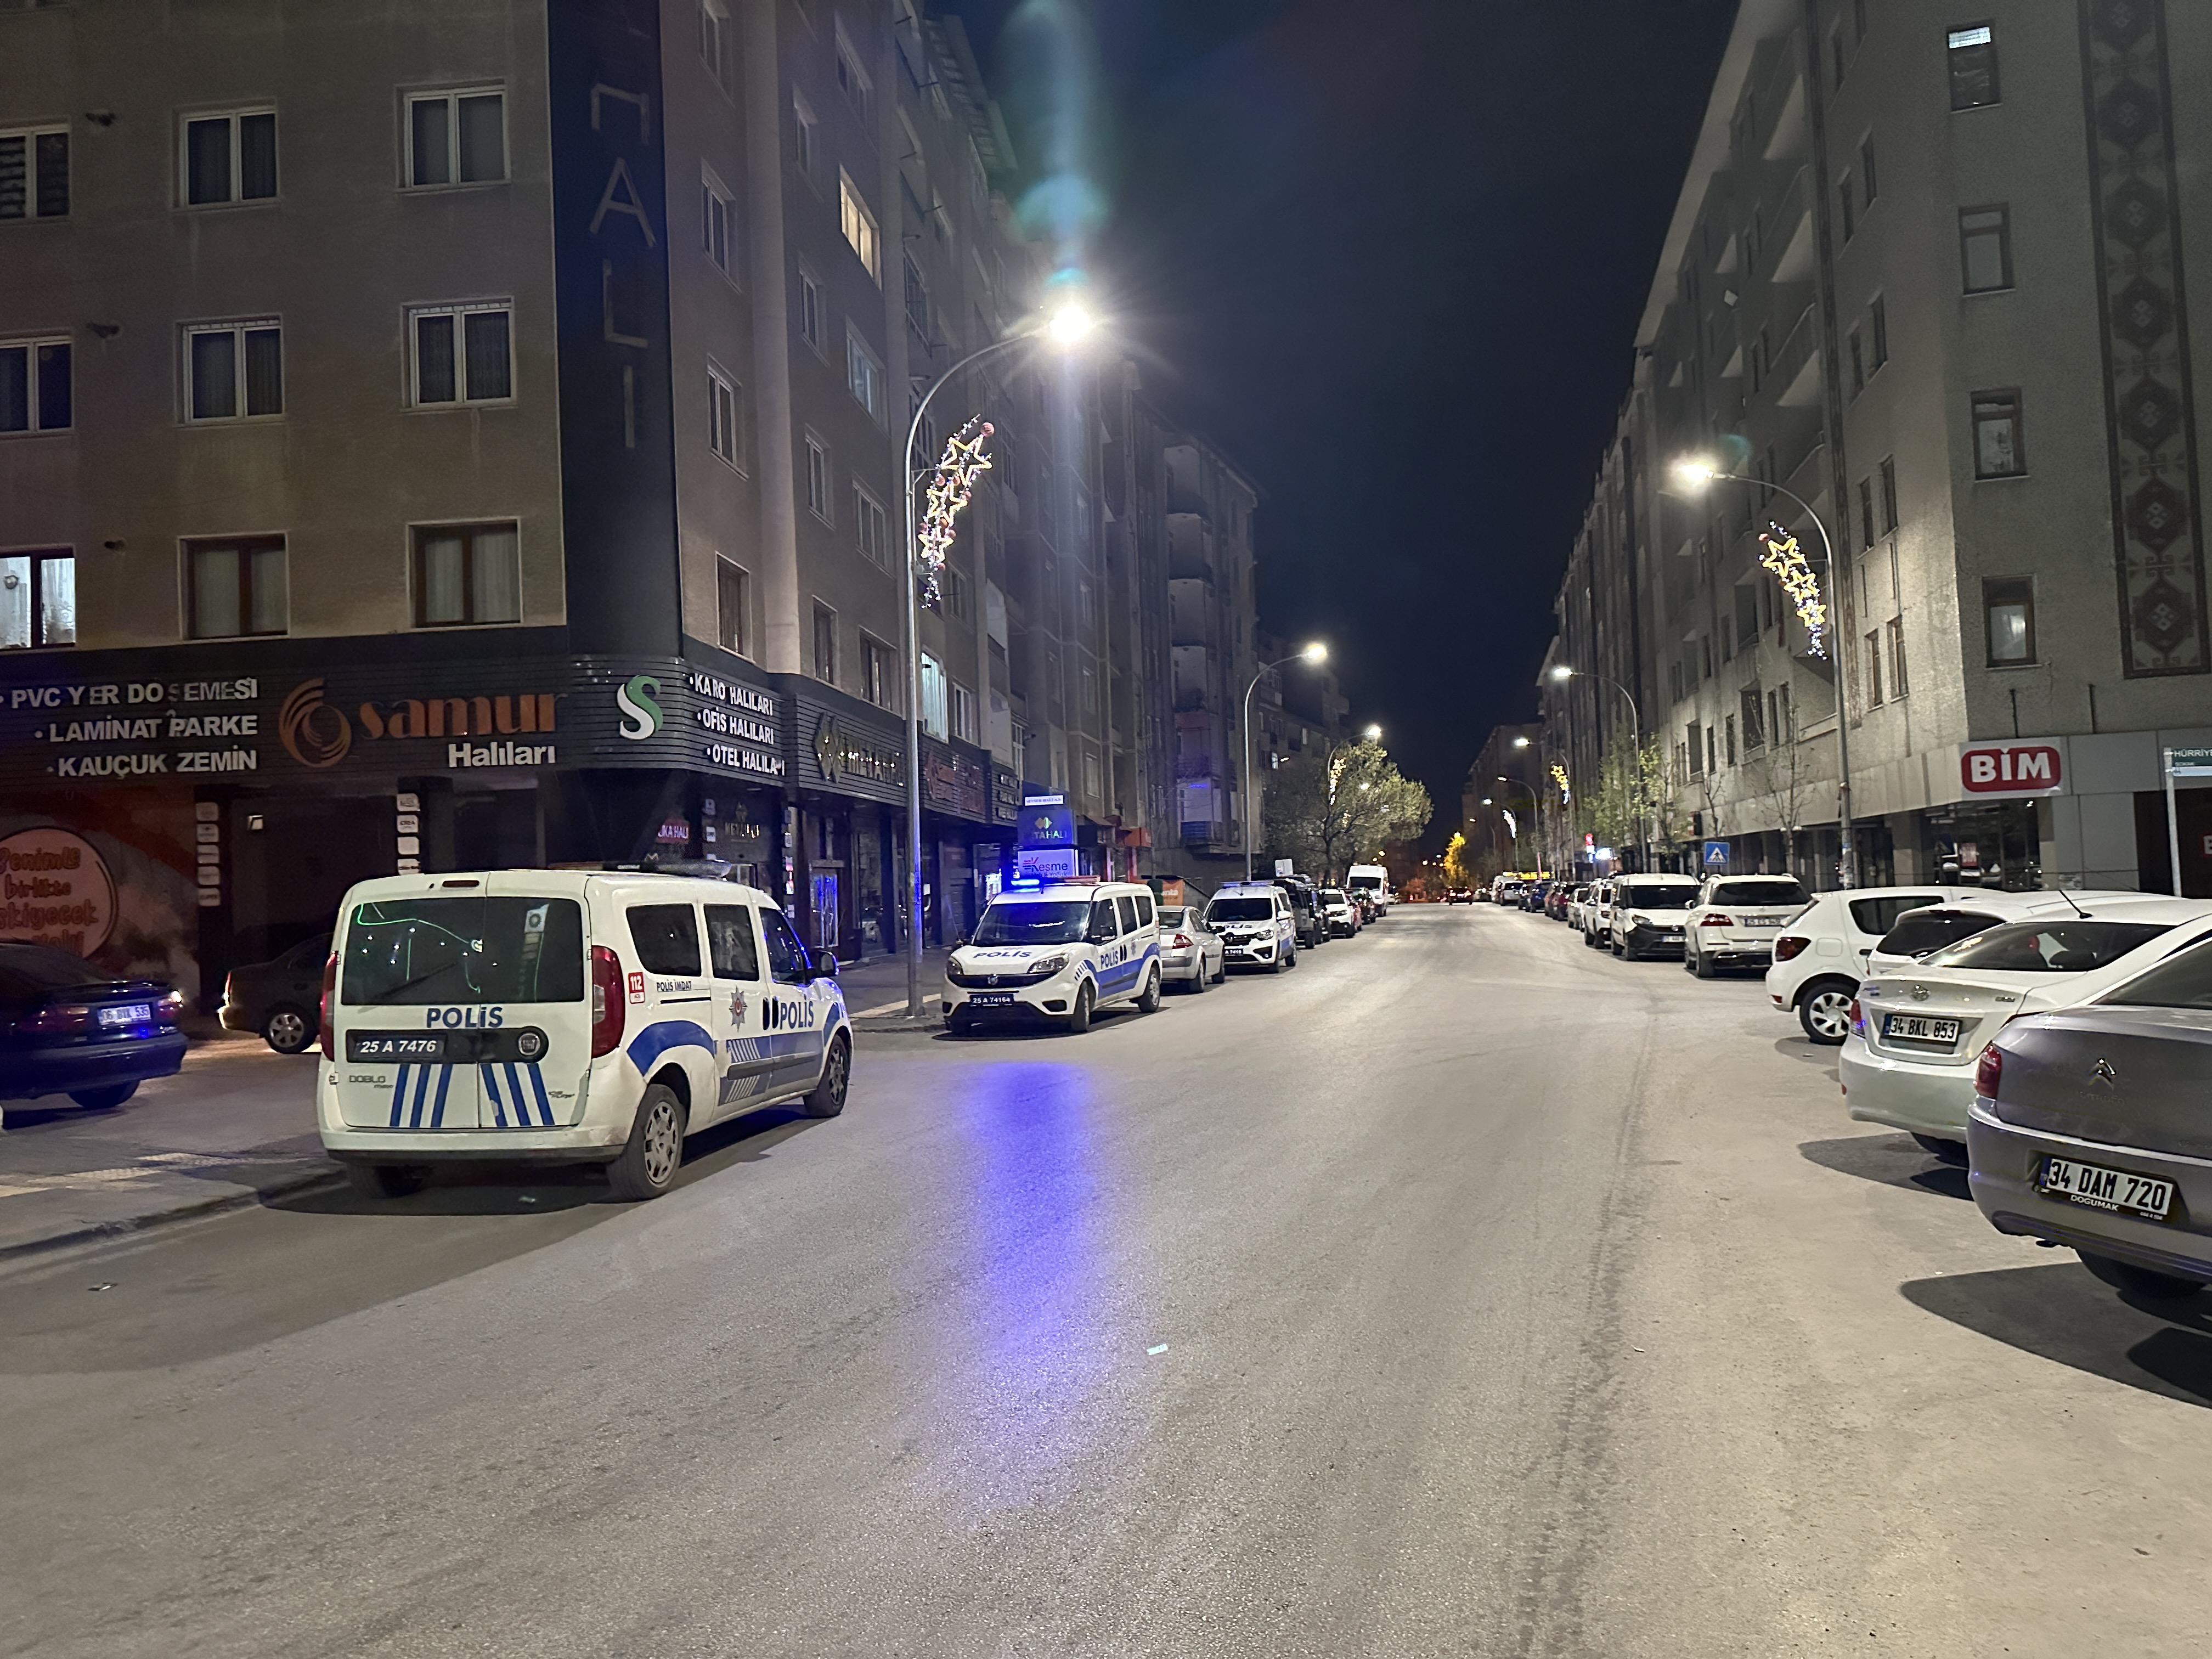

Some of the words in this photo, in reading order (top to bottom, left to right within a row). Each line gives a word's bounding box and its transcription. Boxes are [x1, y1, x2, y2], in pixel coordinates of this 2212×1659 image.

[12, 687, 61, 708] PVC
[67, 685, 120, 705] YER
[695, 673, 725, 700] KARO
[730, 686, 773, 716] HALILARI
[49, 715, 162, 742] LAMİNAT
[168, 715, 258, 737] PARKE
[359, 693, 568, 740] samur
[703, 707, 727, 732] OFİS
[730, 716, 774, 745] HALILARI
[58, 753, 168, 780] KAUÇUK
[176, 744, 257, 772] ZEMİN
[448, 741, 556, 768] Halıları
[713, 744, 740, 767] OTEL
[1101, 947, 1119, 970] POLİS
[630, 975, 643, 991] 112
[657, 979, 673, 992] POLİS
[673, 979, 692, 991] İMDAT
[427, 1007, 503, 1028] POLİS
[780, 994, 814, 1030] POLİS
[1891, 1018, 1904, 1034] 34
[1908, 1019, 1928, 1036] BKL
[1933, 1022, 1956, 1039] 853
[360, 1041, 379, 1052] 25
[382, 1041, 393, 1052] A
[399, 1040, 437, 1052] 7476
[2049, 1161, 2070, 1189] 34
[2078, 1167, 2118, 1200] DAM
[2124, 1177, 2166, 1211] 720
